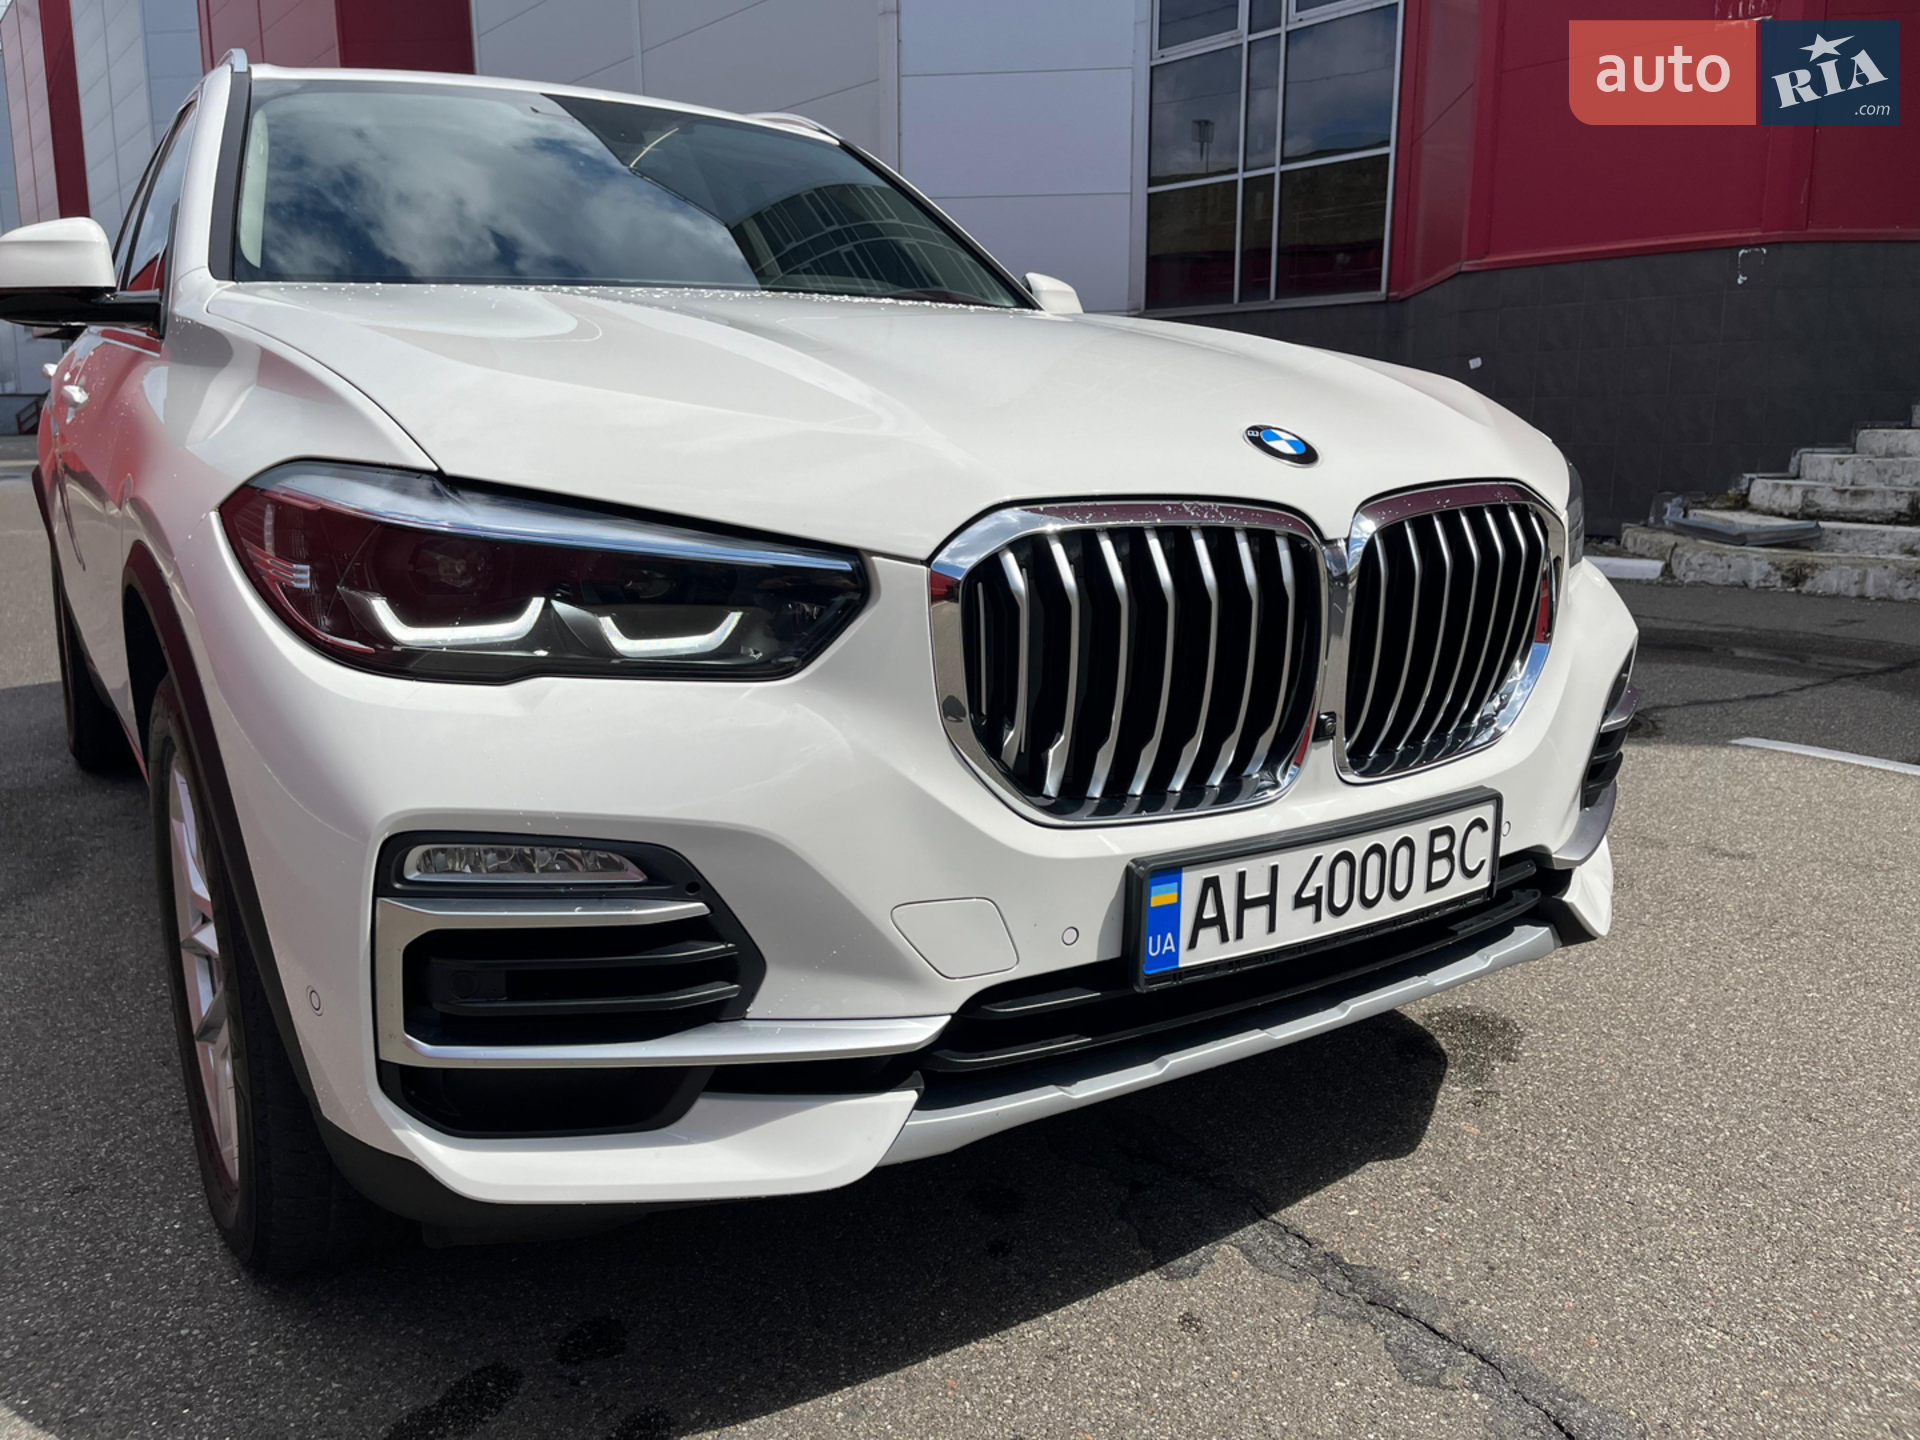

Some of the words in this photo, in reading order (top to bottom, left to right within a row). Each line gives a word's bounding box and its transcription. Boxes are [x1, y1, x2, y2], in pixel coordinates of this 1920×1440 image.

[1187, 862, 1281, 951] AH
[1293, 836, 1416, 924] 4000
[1424, 817, 1489, 893] BC
[1148, 933, 1176, 957] UA
